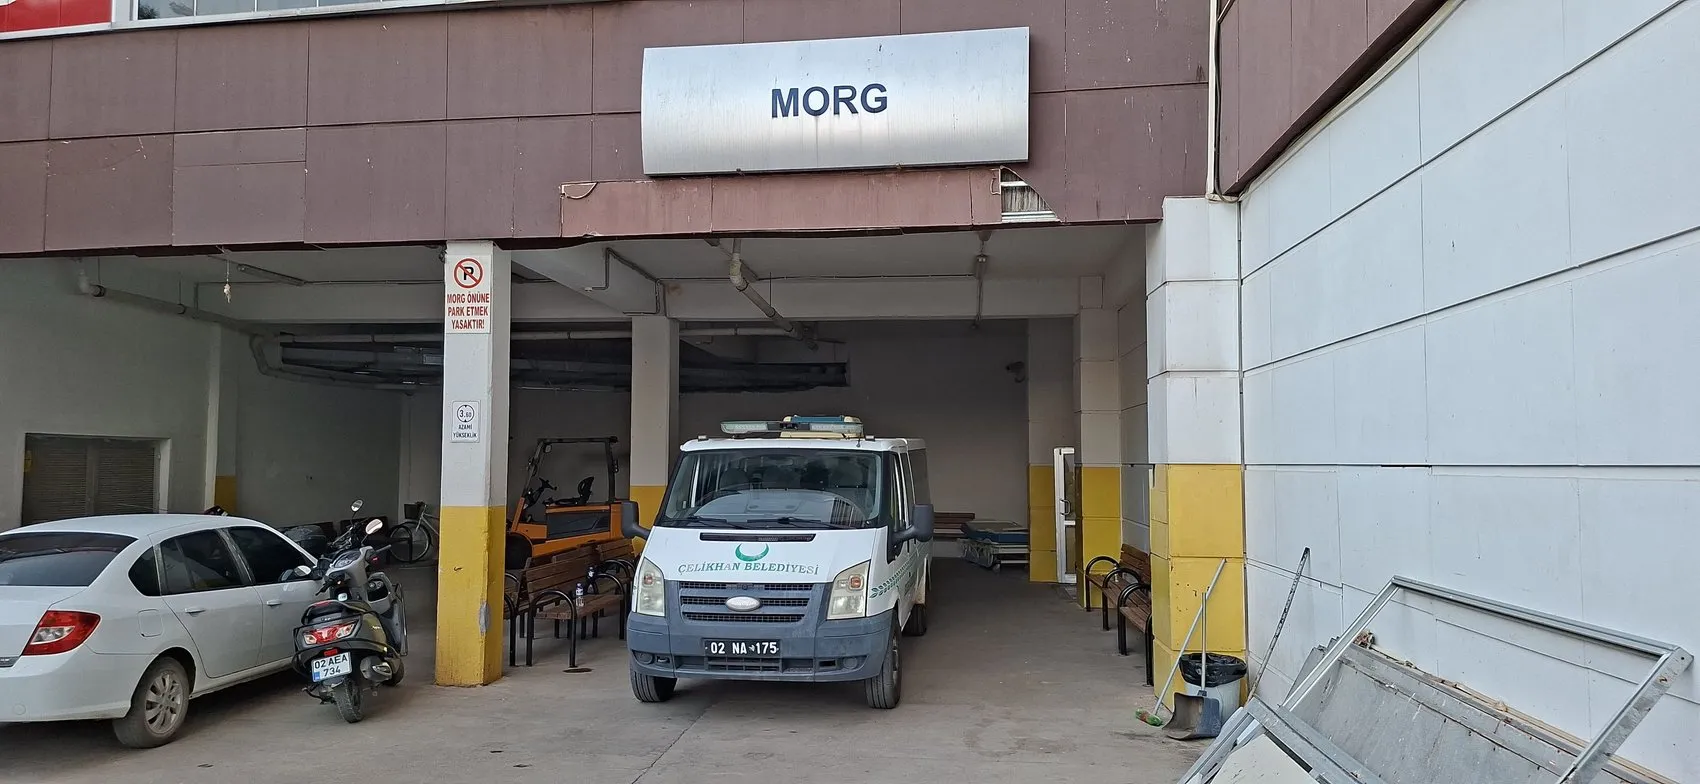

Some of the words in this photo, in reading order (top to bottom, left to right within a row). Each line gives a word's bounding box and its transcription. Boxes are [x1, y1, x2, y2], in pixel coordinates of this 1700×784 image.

[771, 83, 888, 118] MORG
[447, 293, 466, 304] MORG
[467, 291, 490, 304] ÖNÜNE
[447, 306, 465, 317] PARK
[466, 306, 489, 317] ETMEK
[451, 319, 485, 330] YASAKTIR!
[678, 561, 741, 575] ÇELİKHAN
[744, 562, 819, 575] BELEDİYESİ
[710, 641, 726, 654] 02
[732, 642, 748, 655] NA
[755, 641, 777, 654] 175
[314, 659, 326, 669] 02
[328, 654, 348, 666] AEA
[323, 665, 341, 676] 734
